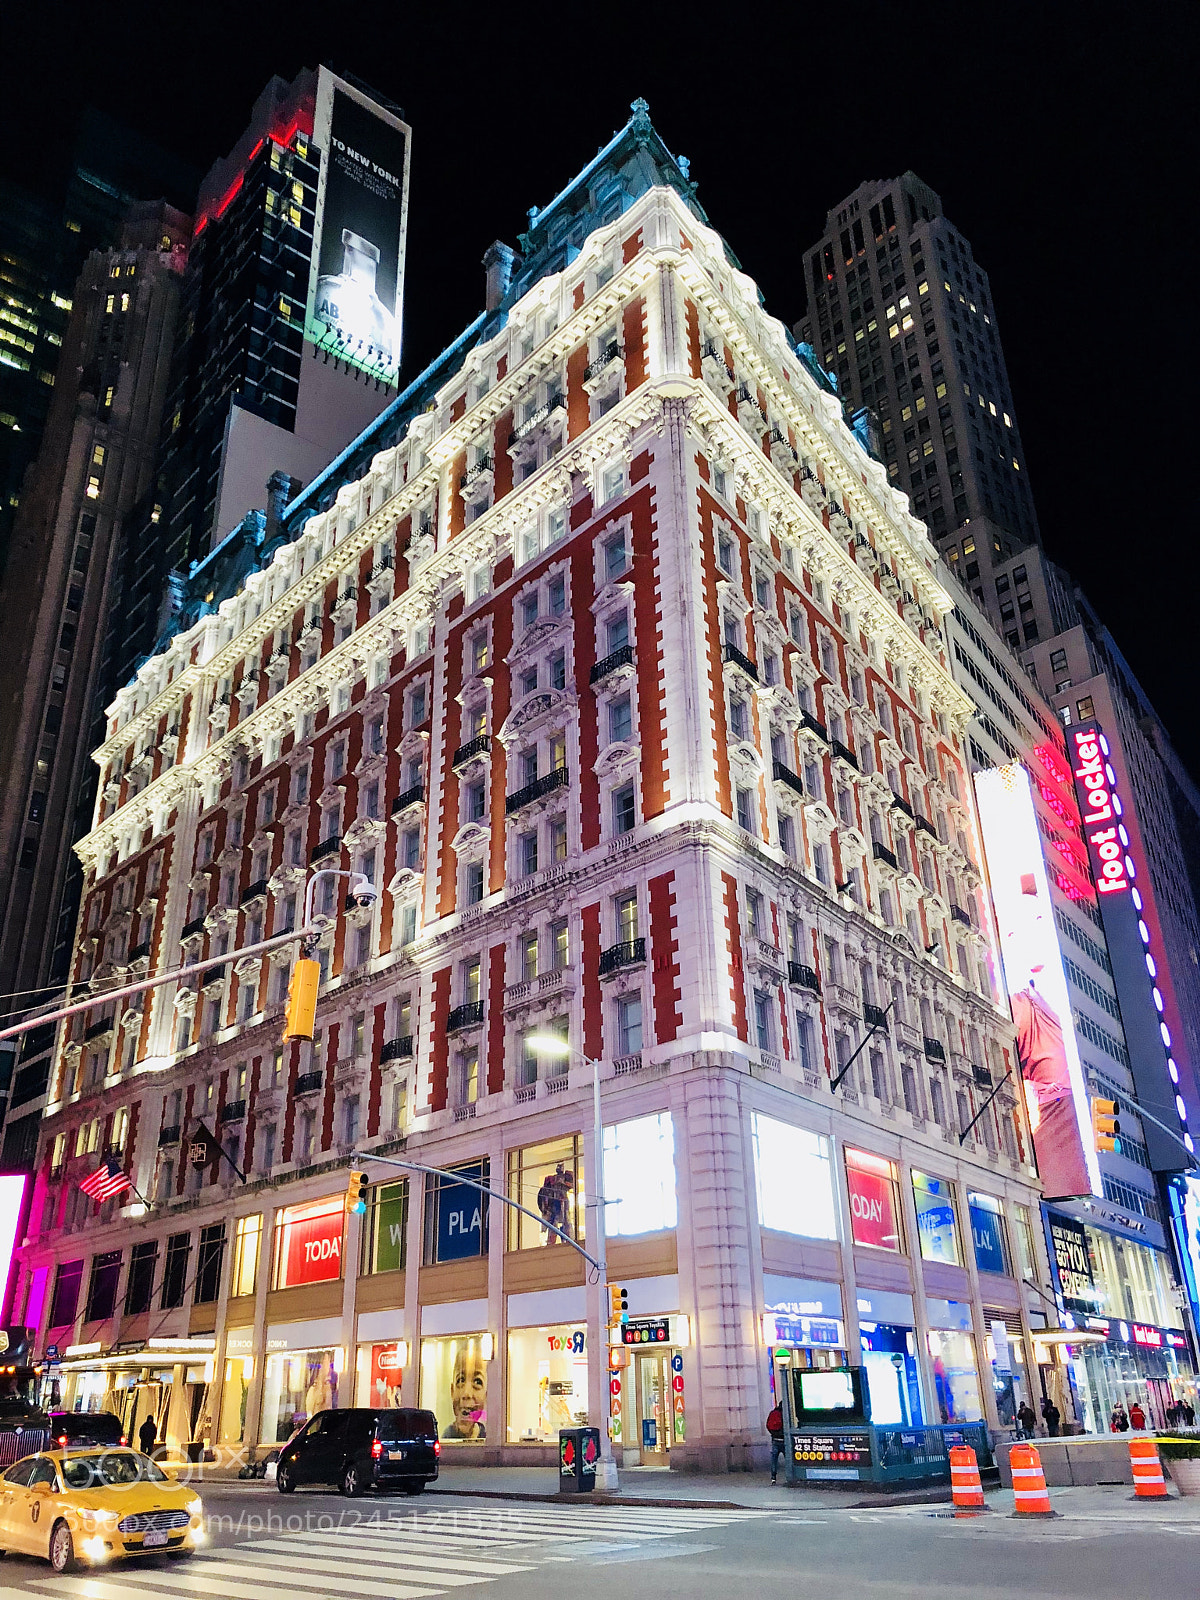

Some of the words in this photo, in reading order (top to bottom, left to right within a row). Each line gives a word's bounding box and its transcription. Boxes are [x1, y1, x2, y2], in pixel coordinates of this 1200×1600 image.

[332, 136, 346, 151] TO
[347, 146, 370, 167] NEW
[1091, 827, 1127, 892] Foot
[850, 1192, 882, 1222] ODAY
